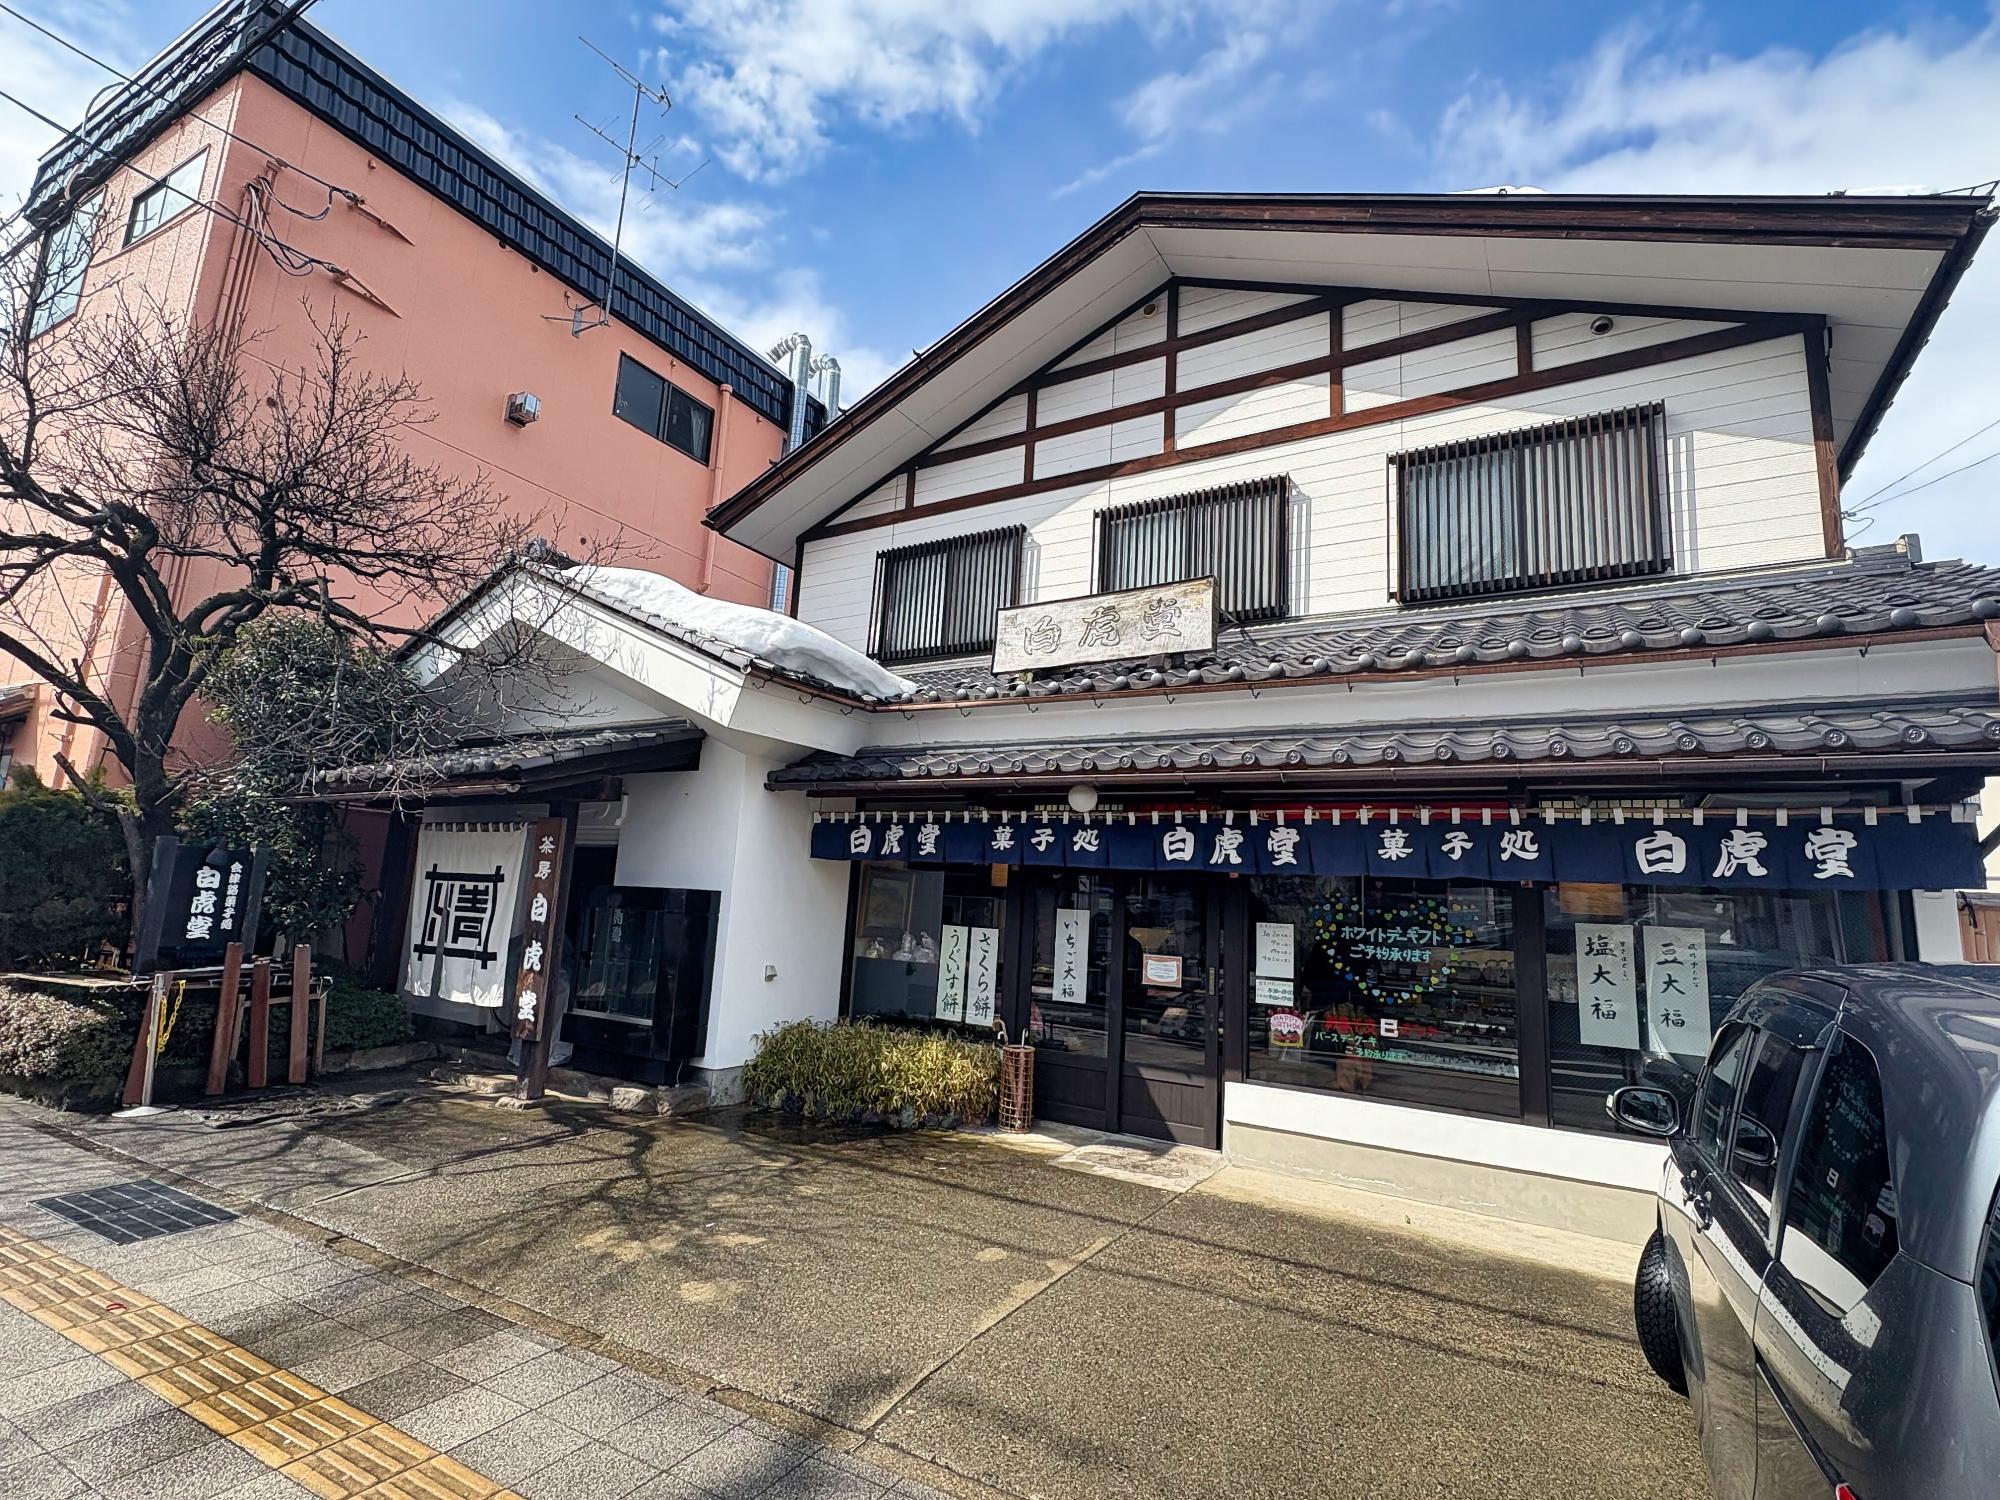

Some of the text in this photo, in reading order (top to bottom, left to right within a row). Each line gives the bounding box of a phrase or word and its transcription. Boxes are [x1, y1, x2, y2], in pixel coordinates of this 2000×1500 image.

[850, 823, 1858, 879] 白虎堂 菓子処 白虎堂 菓子処 白虎堂
[185, 865, 221, 940] 白虎堂
[517, 836, 556, 1022] 茶房 白虎堂
[1340, 925, 1442, 946] ホワイトデーギフト
[941, 928, 961, 1016] うぐいす餅
[973, 931, 992, 1020] さくら餅
[1061, 920, 1080, 999] いちご大福
[1349, 943, 1432, 964] ご予約承ります
[1584, 934, 1618, 1021] 塩大福
[1656, 942, 1687, 1029] 豆大福
[1314, 1031, 1378, 1048] バースデーケーキ
